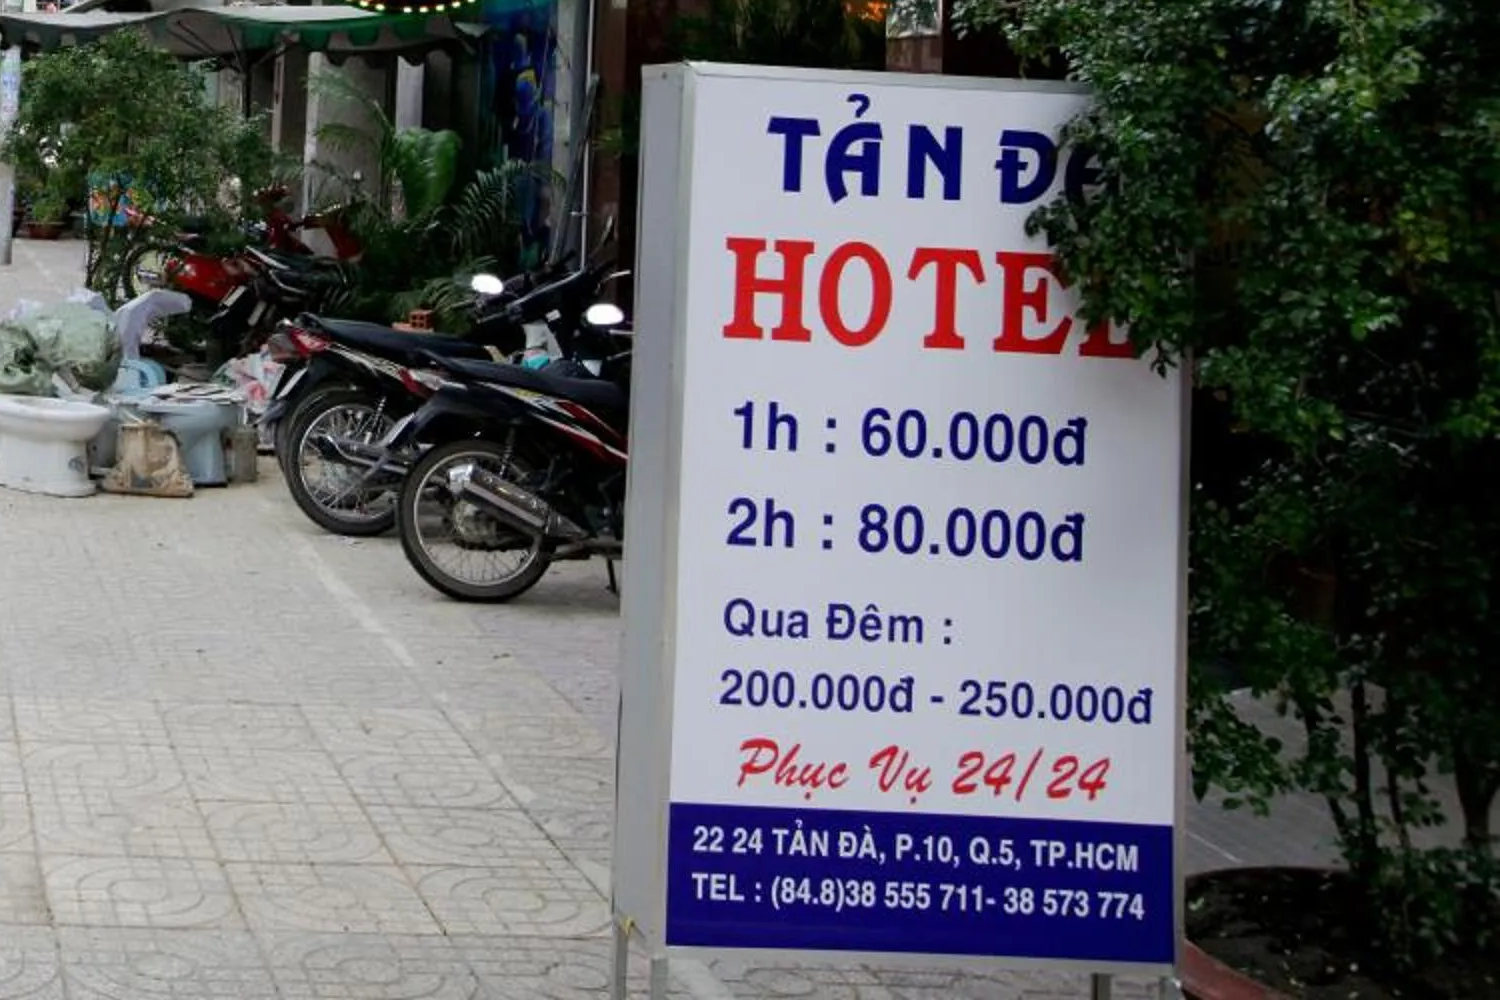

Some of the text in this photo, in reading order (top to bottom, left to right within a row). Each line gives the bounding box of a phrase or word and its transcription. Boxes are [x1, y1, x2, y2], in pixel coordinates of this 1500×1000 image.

[767, 93, 963, 204] TẢN
[733, 401, 798, 452] 1h
[861, 407, 1088, 467] 60.000đ
[726, 497, 795, 548] 2h
[858, 503, 1086, 563] 80.000đ
[723, 598, 809, 640] Qua
[826, 602, 924, 644] Đêm
[719, 669, 915, 713] 200.000đ
[958, 679, 1154, 725] 250.000đ
[736, 737, 1113, 804] Phục Vụ 24/24
[692, 818, 1139, 872] 22 24 TẢN ĐÀ, P.10, Q.5, TP.HCM
[691, 872, 745, 902] TEL
[770, 875, 876, 912] (84.8)38
[884, 880, 931, 909] 555
[1003, 886, 1035, 915] 38
[1042, 888, 1090, 917] 573
[1097, 891, 1146, 921] 774
